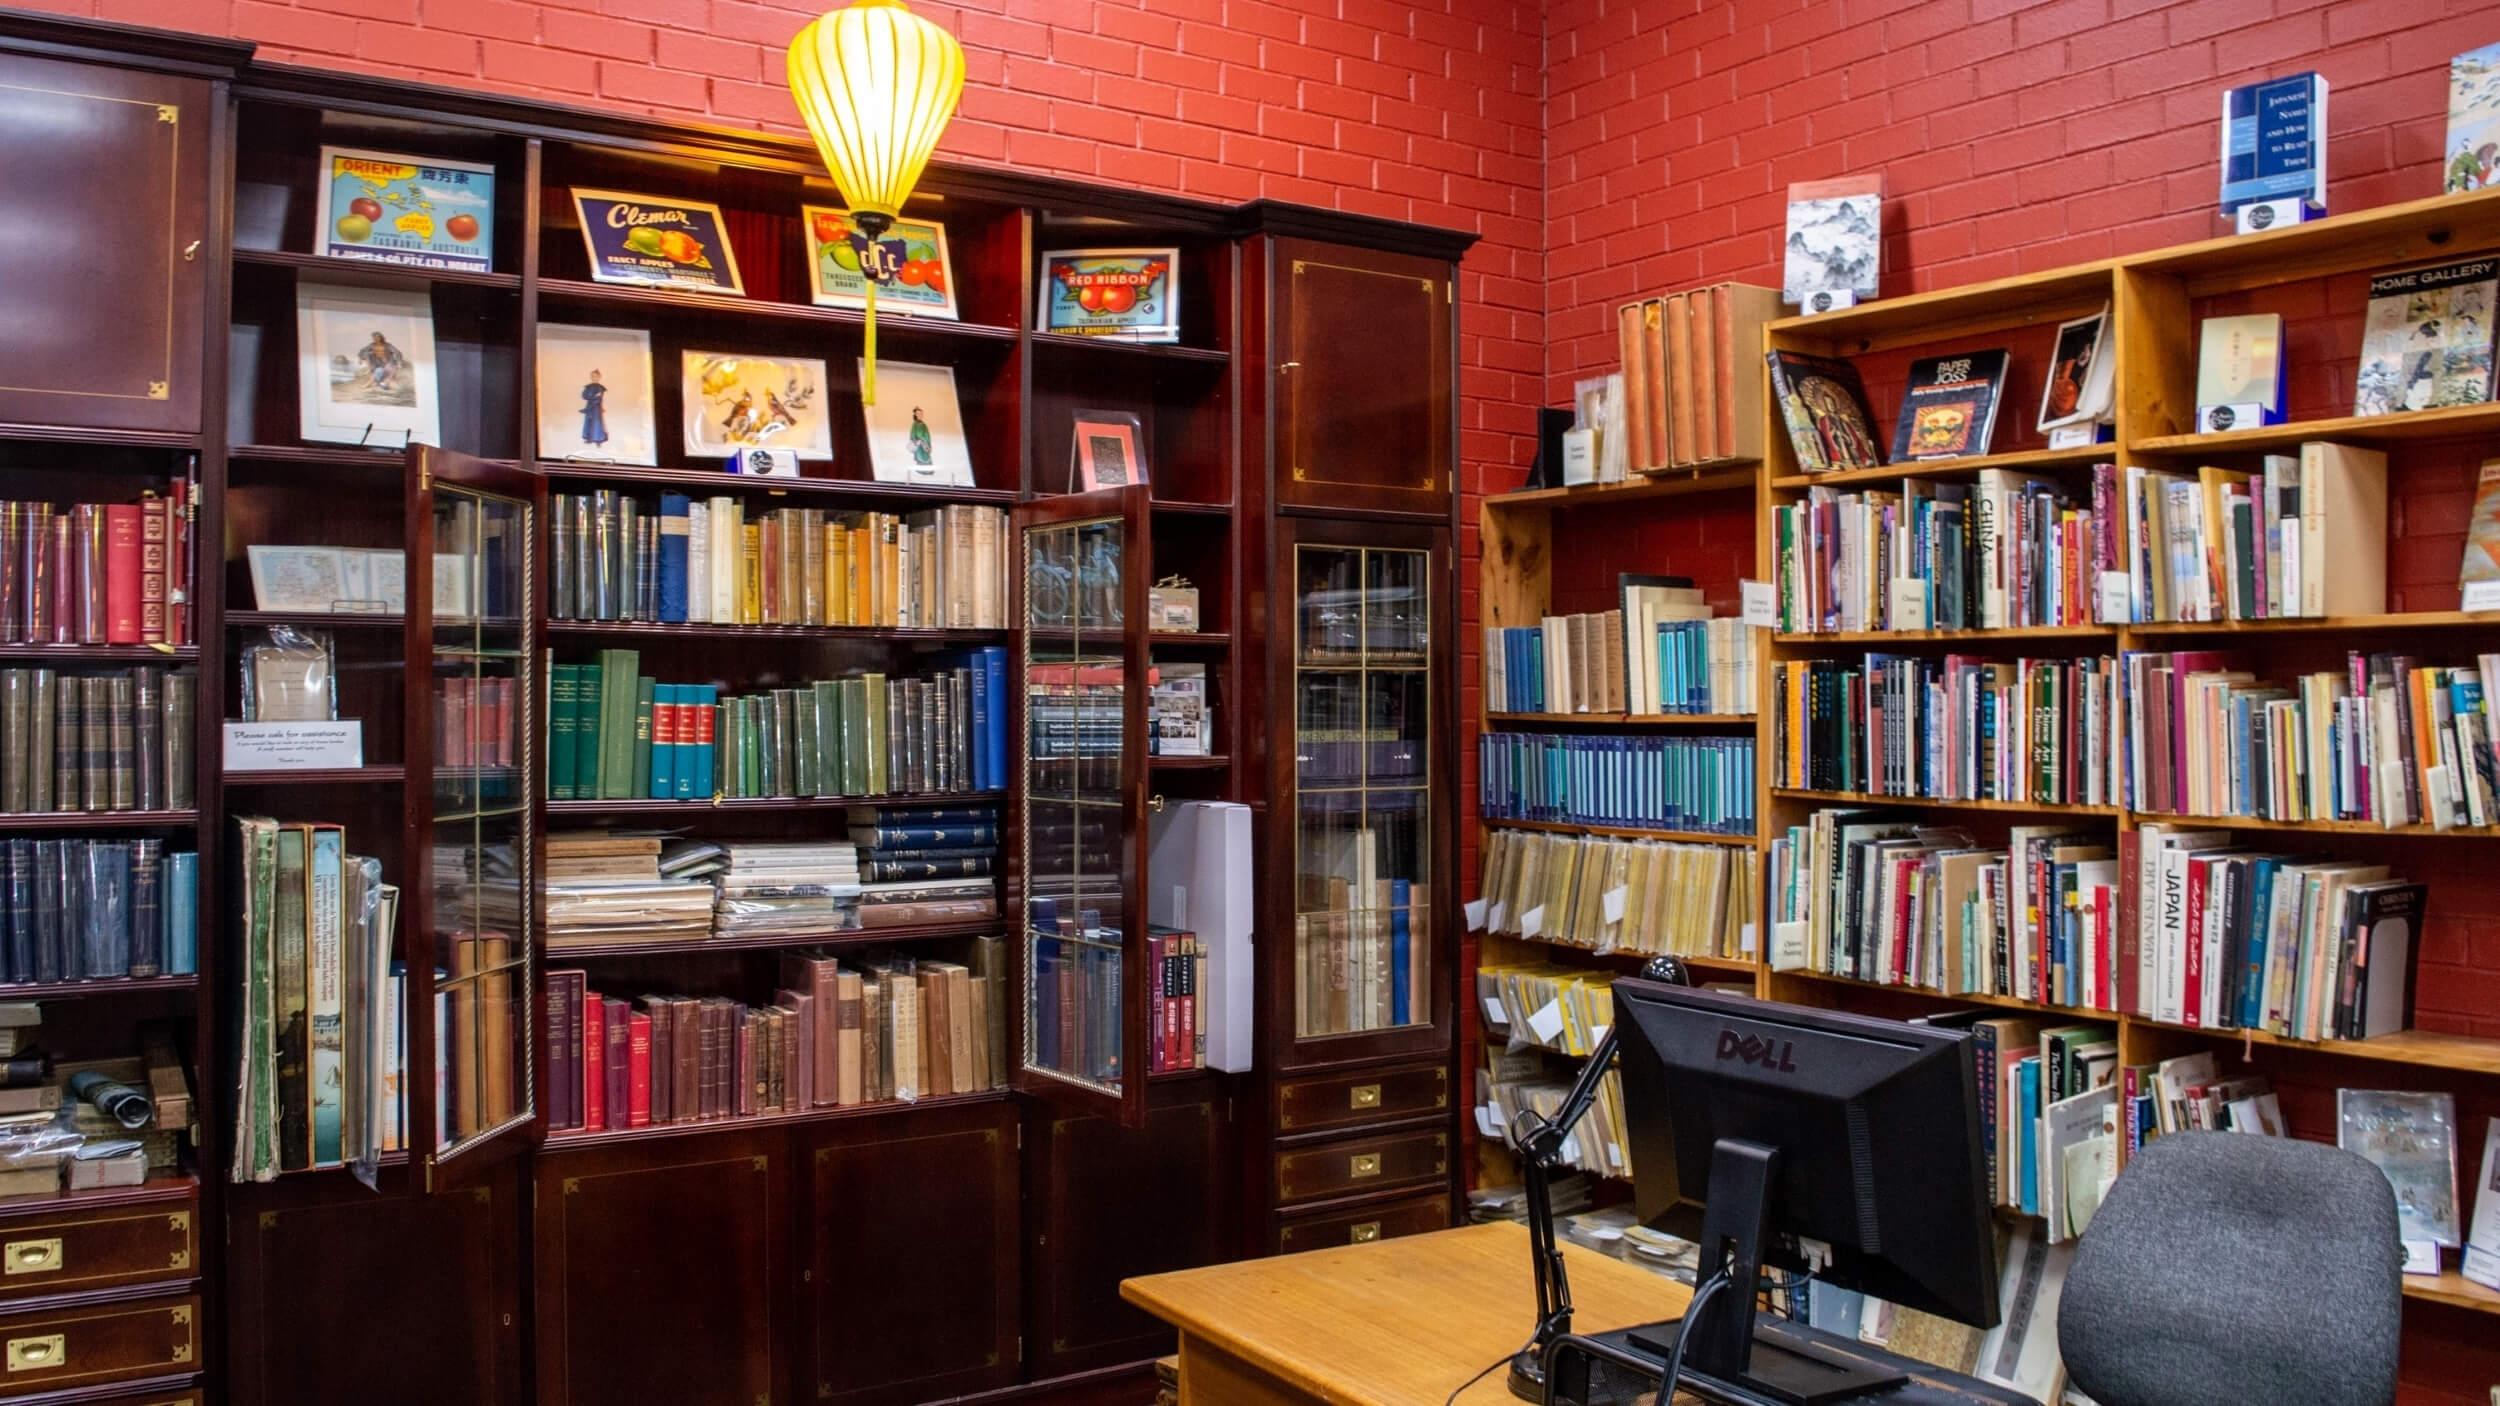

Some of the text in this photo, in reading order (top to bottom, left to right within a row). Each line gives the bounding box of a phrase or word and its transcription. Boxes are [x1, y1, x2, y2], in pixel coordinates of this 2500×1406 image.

[343, 159, 404, 177] ORIENT
[606, 203, 691, 229] Clemar
[1067, 273, 1149, 286] RED RIBBON
[2370, 262, 2495, 292] HOME GALLERY
[1933, 371, 1968, 385] JOSS
[1981, 498, 1994, 556] CHINA
[2034, 707, 2042, 762] Chinese Art
[2043, 706, 2051, 744] Chinese
[2043, 745, 2051, 762] Art
[2165, 868, 2181, 930] JAPAN
[1716, 1028, 1797, 1073] DELL
